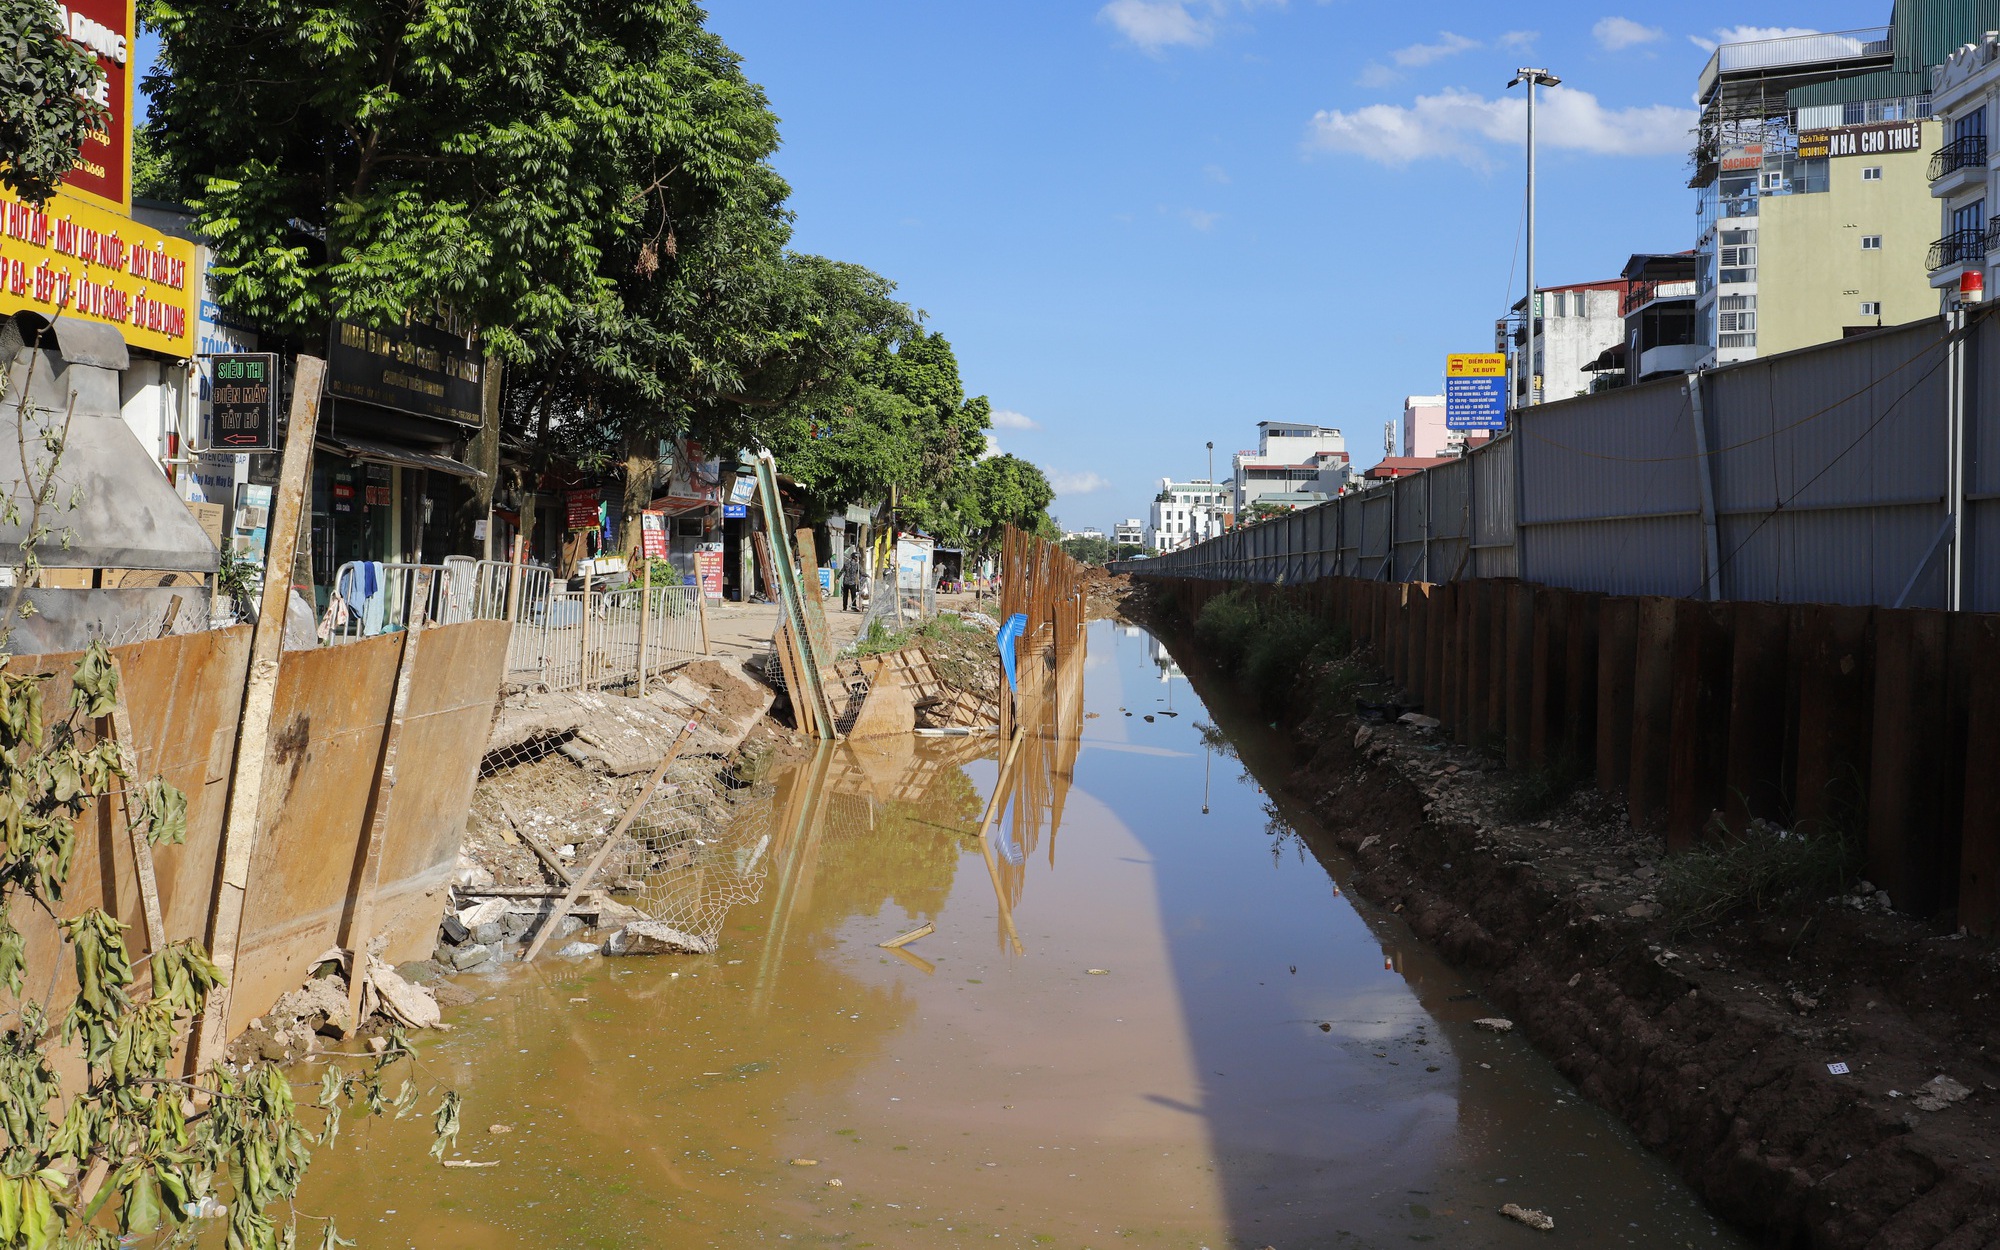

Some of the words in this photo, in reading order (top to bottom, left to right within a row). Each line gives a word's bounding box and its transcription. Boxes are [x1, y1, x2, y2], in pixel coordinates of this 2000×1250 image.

[1831, 130, 1856, 156] NHÀ
[1862, 130, 1884, 152] CHO
[1888, 123, 1919, 150] THUÊ
[6, 196, 30, 240] HÚT
[54, 214, 79, 255] MÁY
[78, 226, 98, 267] LỌC
[97, 230, 124, 270] NƯỚC
[129, 240, 150, 278] MÁY
[150, 241, 168, 286] RỬA
[9, 259, 26, 294] GA
[33, 258, 55, 301] BẾP
[76, 272, 90, 312] LÒ
[90, 282, 101, 316] VI
[102, 280, 127, 322] SÓNG
[132, 286, 147, 326] ĐỒ
[147, 299, 163, 332] GIA
[162, 303, 185, 339] DỤNG
[340, 322, 366, 350] MUA
[218, 359, 244, 379] SIÊU
[246, 362, 264, 382] THỊ
[214, 384, 240, 408] ĐIỆN
[222, 409, 242, 429] TÂY
